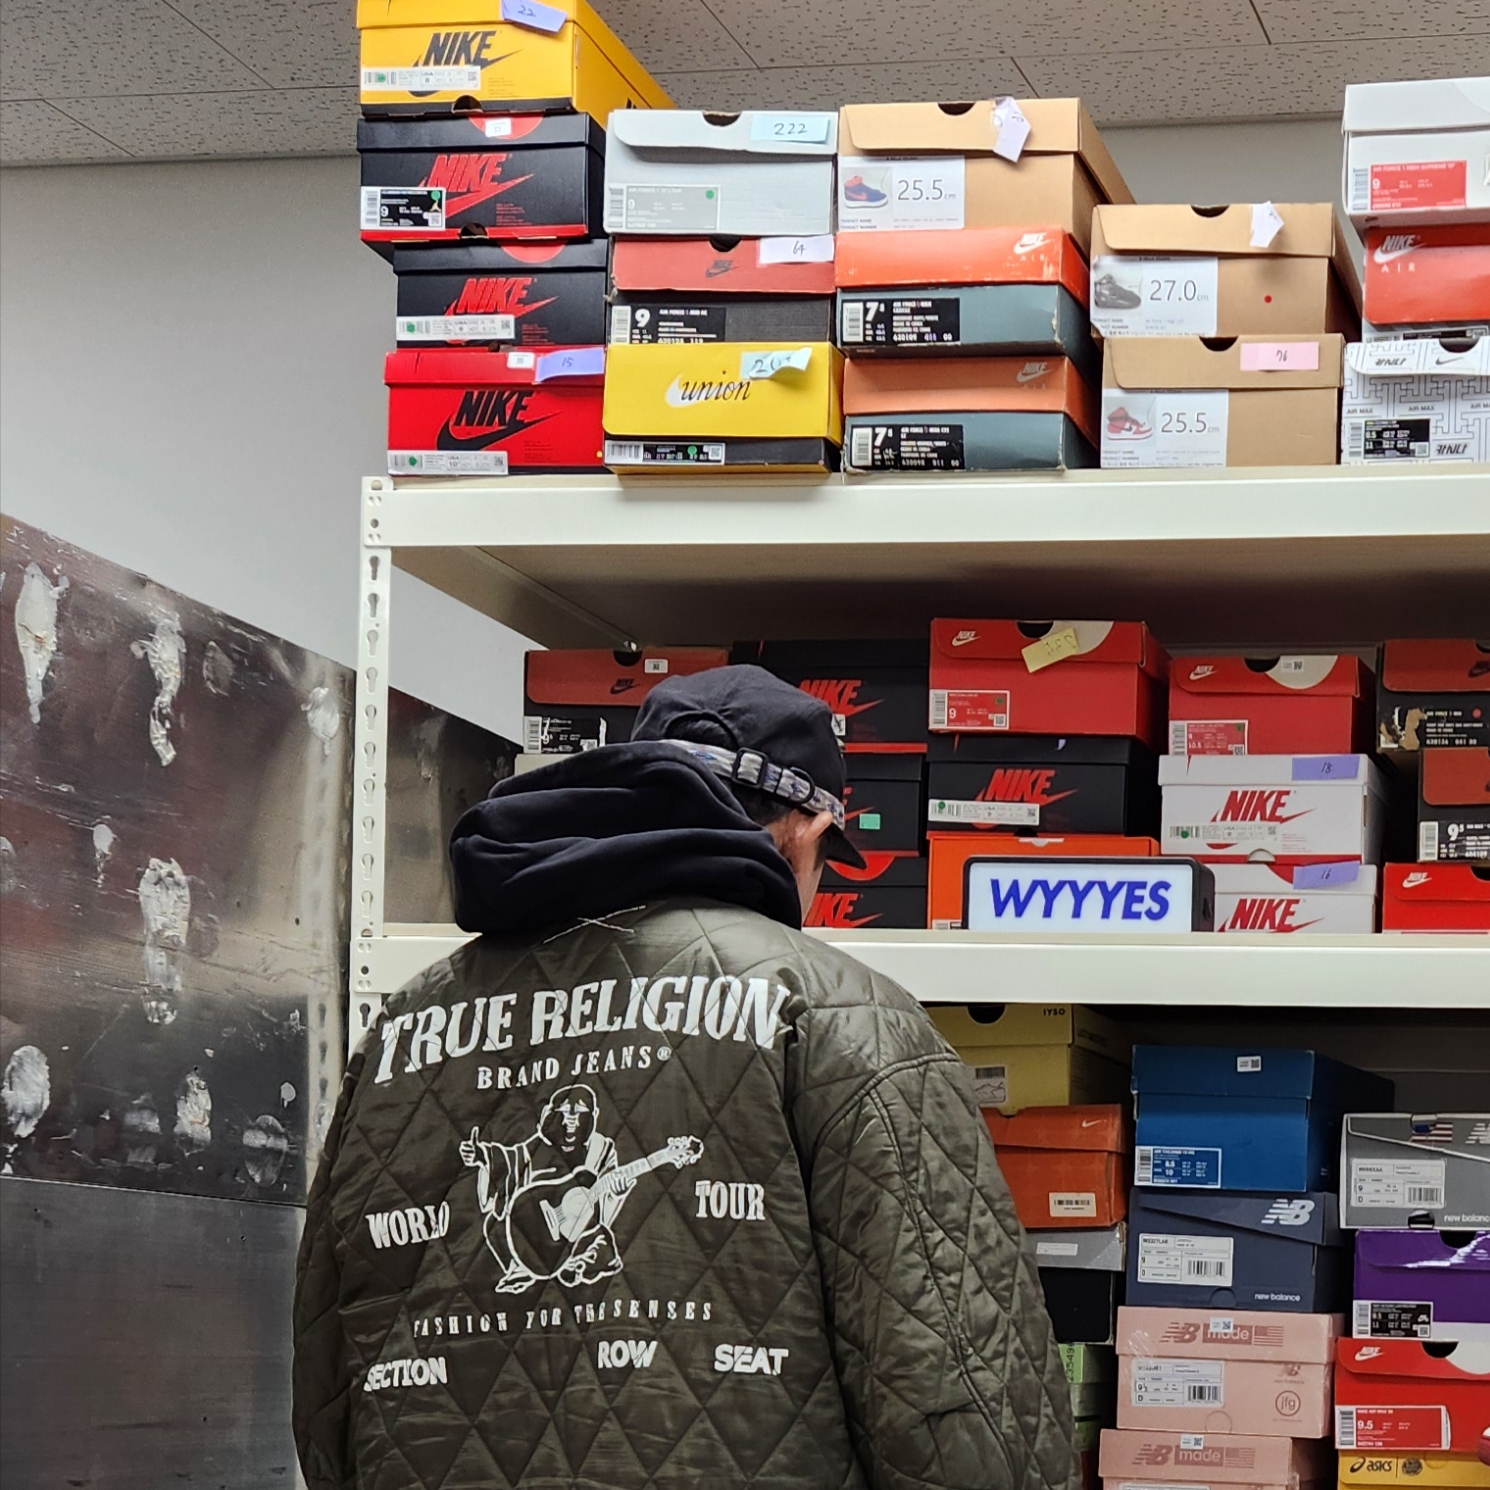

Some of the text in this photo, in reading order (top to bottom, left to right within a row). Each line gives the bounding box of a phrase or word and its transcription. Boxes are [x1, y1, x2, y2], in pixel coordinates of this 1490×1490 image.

[423, 30, 496, 66] NIKE
[774, 122, 808, 135] 222
[429, 154, 503, 191] NIKE
[1372, 178, 1380, 189] 9
[628, 199, 635, 209] 9
[1022, 233, 1047, 244] NIKE
[1382, 235, 1415, 250] NIKE
[1381, 263, 1415, 273] AIR
[456, 278, 531, 314] NIKE
[635, 309, 650, 327] 9
[1024, 363, 1047, 373] NIKE
[681, 370, 750, 401] union
[454, 391, 529, 427] NIKE
[957, 630, 976, 640] NIKE
[949, 708, 956, 719] 9
[985, 769, 1056, 800] NIKE
[1220, 789, 1291, 822] NIKE
[804, 893, 858, 928] IKE
[990, 878, 1171, 921] WYYYES
[1227, 898, 1300, 932] NIKE
[1043, 1007, 1066, 1018] IYSO
[374, 975, 790, 1084] TRUE RELIGION
[477, 1054, 561, 1090] BRAND
[695, 1180, 765, 1221] TOUR
[1444, 1214, 1464, 1223] new
[1254, 1292, 1301, 1302] new balance
[413, 1312, 508, 1338] FASHION
[526, 1307, 562, 1330] FOR
[613, 1299, 713, 1320] SENSES
[597, 1340, 657, 1369] ROW
[713, 1343, 789, 1375] SEAT
[1279, 1393, 1297, 1412] jfg
[1357, 1420, 1373, 1429] 9.5
[1178, 1448, 1221, 1463] made
